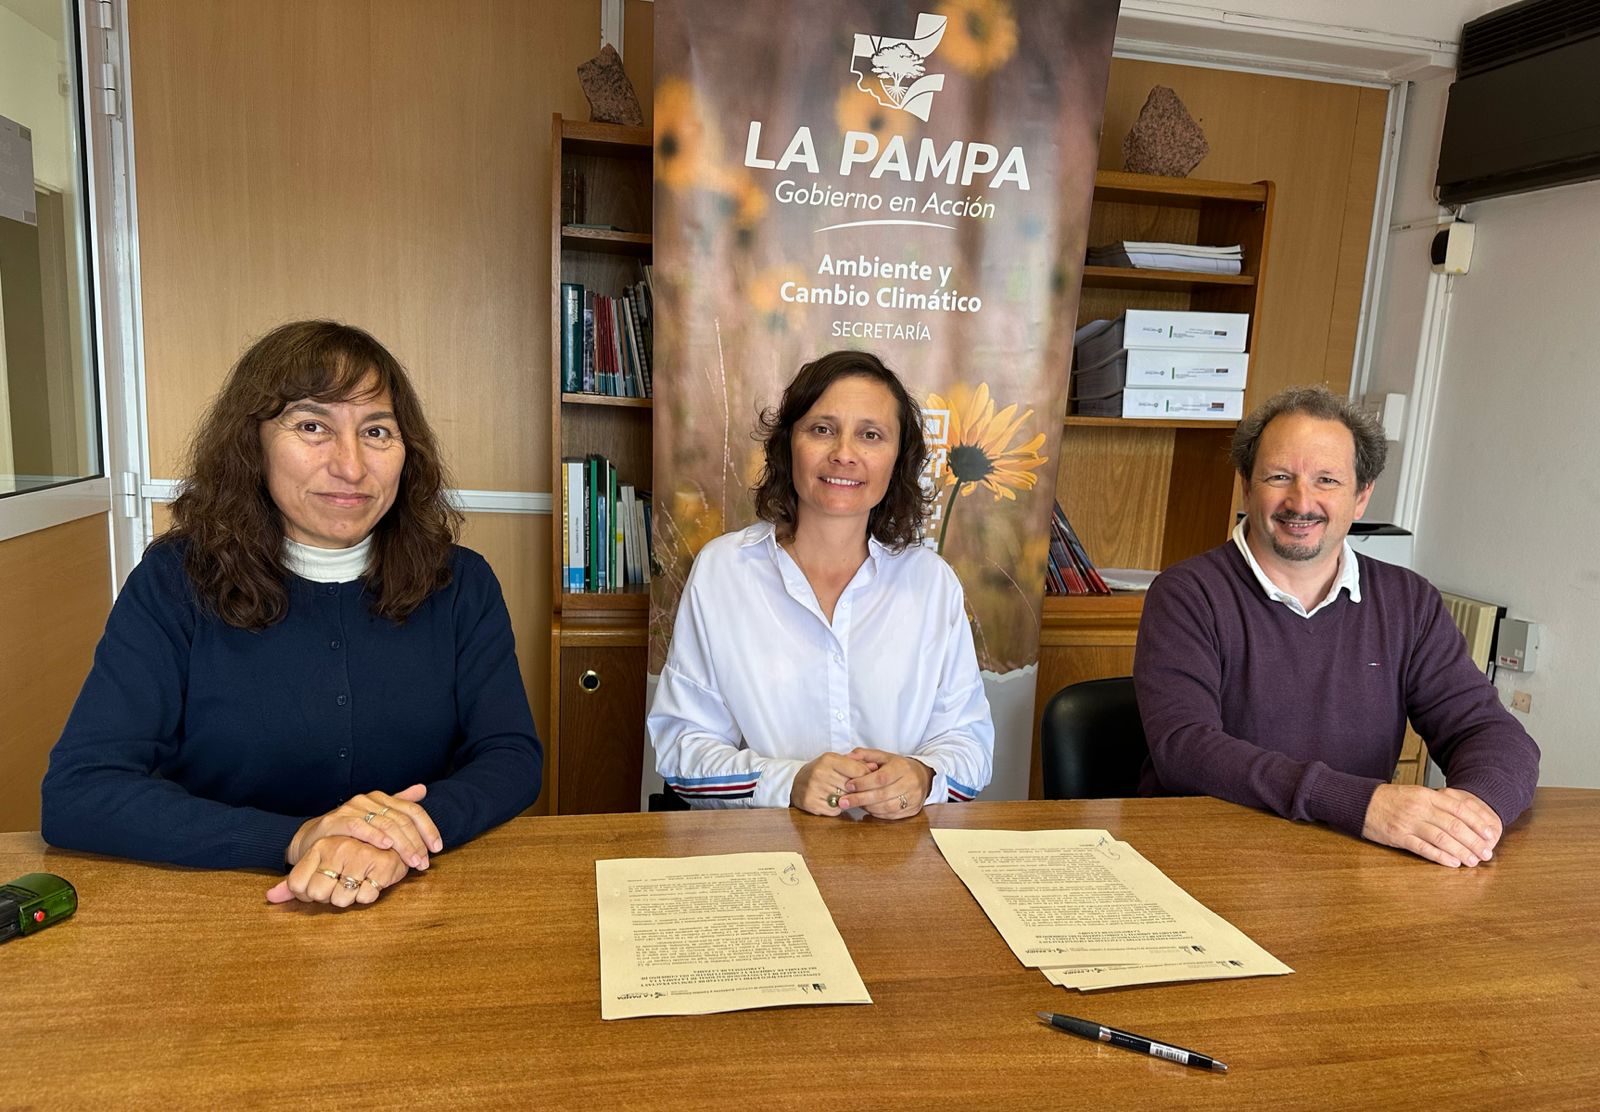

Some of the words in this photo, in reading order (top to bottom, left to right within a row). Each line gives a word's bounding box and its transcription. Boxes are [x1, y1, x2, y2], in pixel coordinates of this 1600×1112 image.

[744, 121, 820, 174] LA
[839, 130, 1031, 191] PAMPA
[775, 180, 882, 211] Gobierno
[889, 194, 916, 213] en
[921, 192, 996, 219] Acción
[817, 254, 933, 281] Ambiente
[938, 265, 952, 287] y
[779, 282, 870, 307] Cambio
[876, 287, 982, 313] Climático
[832, 320, 931, 341] SECRETARÍA
